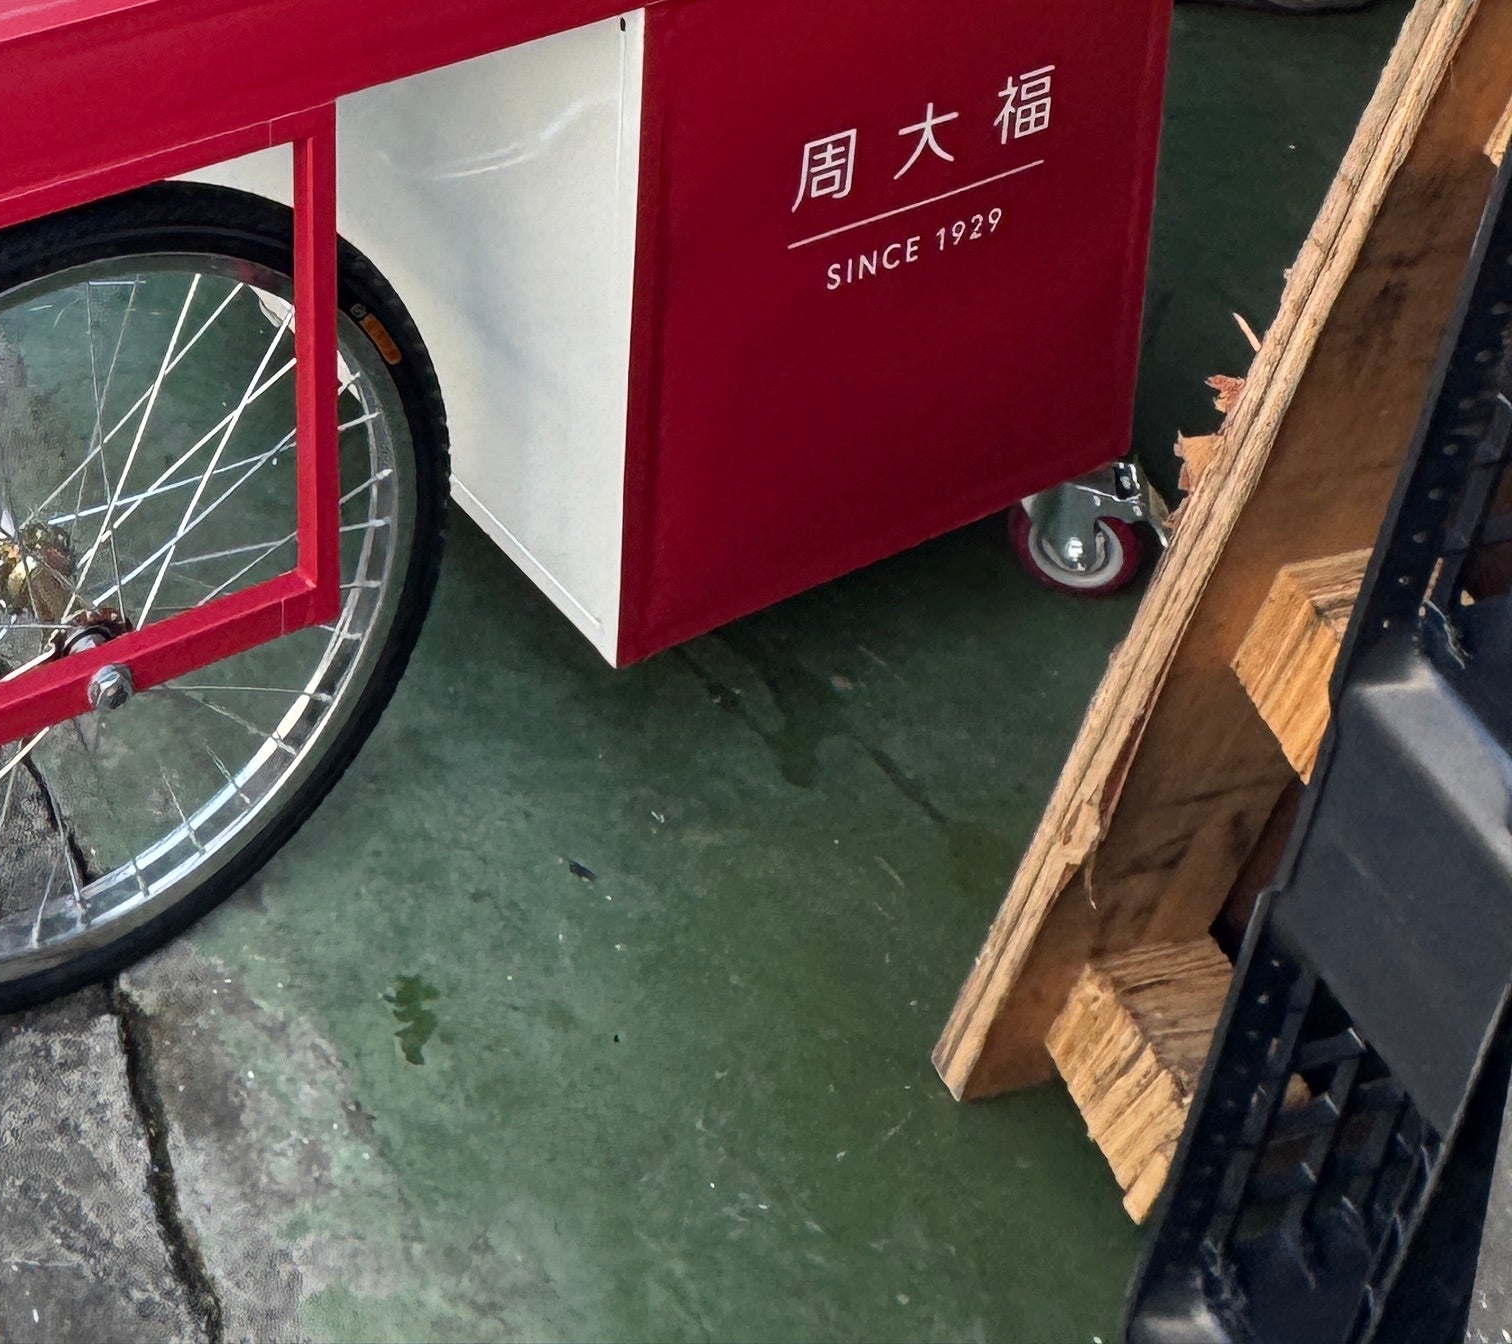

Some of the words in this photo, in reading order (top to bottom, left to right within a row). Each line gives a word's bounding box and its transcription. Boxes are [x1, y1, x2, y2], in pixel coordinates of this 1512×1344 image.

[792, 64, 1056, 213] 周大福
[826, 235, 921, 291] SINCE
[936, 207, 1003, 252] 1929
